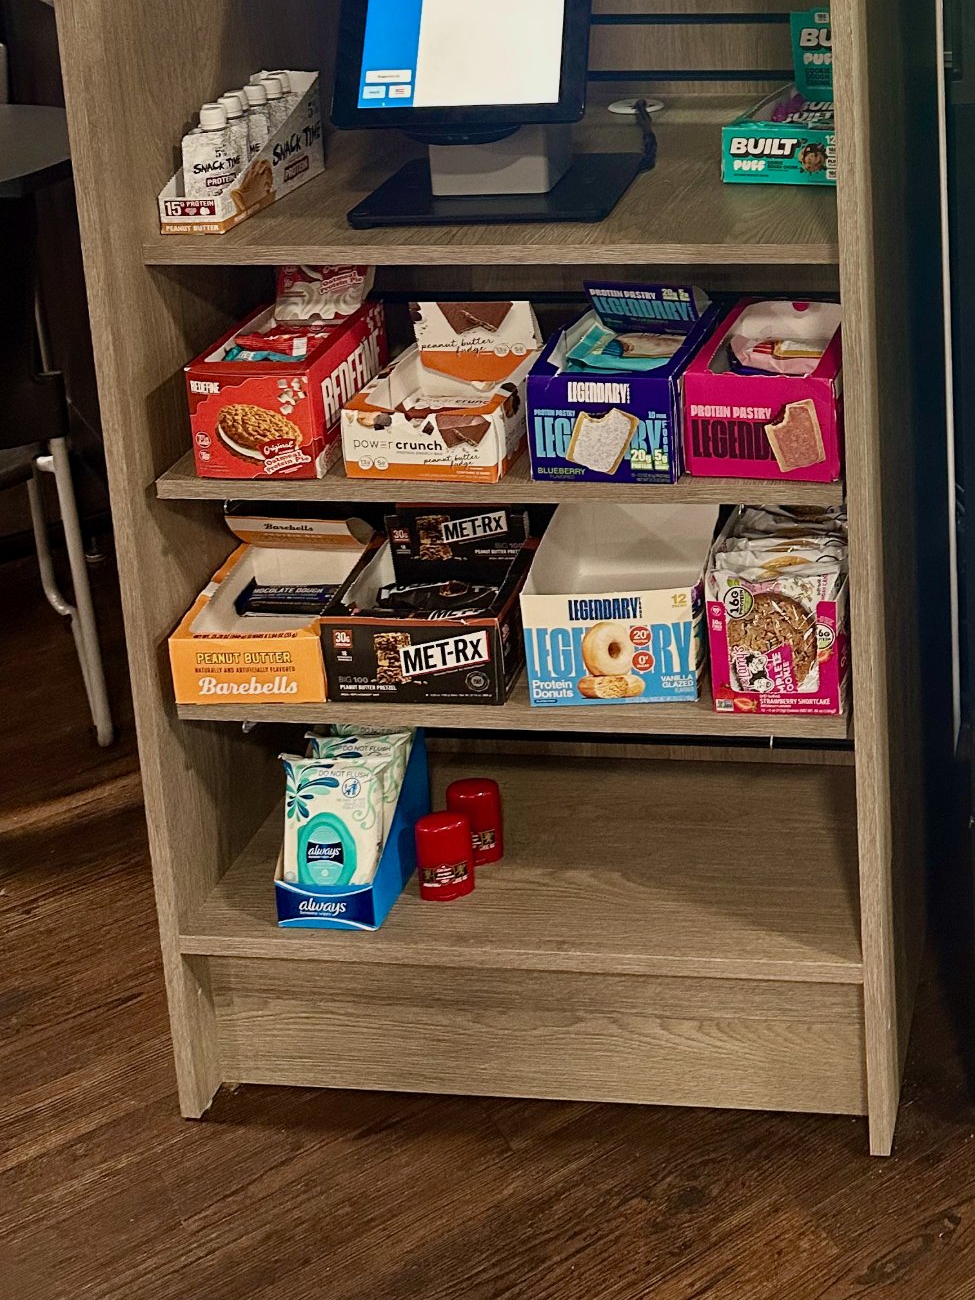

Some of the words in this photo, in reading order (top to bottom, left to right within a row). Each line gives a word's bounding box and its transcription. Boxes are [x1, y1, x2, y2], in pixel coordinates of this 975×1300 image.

[730, 138, 797, 155] BUILT
[194, 161, 224, 174] SNACK
[733, 160, 766, 171] PUFF
[592, 297, 689, 320] LEGENDARY
[422, 341, 457, 350] peanut
[461, 338, 494, 346] butter
[190, 381, 220, 394] REDEFINE
[568, 382, 628, 403] LEGENDARY
[690, 405, 730, 418] PROTEIN
[734, 406, 772, 420] PASTRY
[264, 441, 293, 454] Original
[396, 440, 442, 450] crunch
[263, 523, 314, 532] Barebells
[672, 594, 687, 604] 12
[568, 597, 640, 620] LEGENDARY
[197, 653, 240, 664] PEANUT
[244, 652, 291, 663] BUTTER
[403, 638, 483, 673] MET-Rx
[199, 676, 297, 695] Barebells
[533, 680, 573, 690] Protein
[533, 689, 574, 699] Donuts
[330, 770, 345, 778] NOT
[308, 846, 342, 857] always
[299, 898, 347, 916] always
